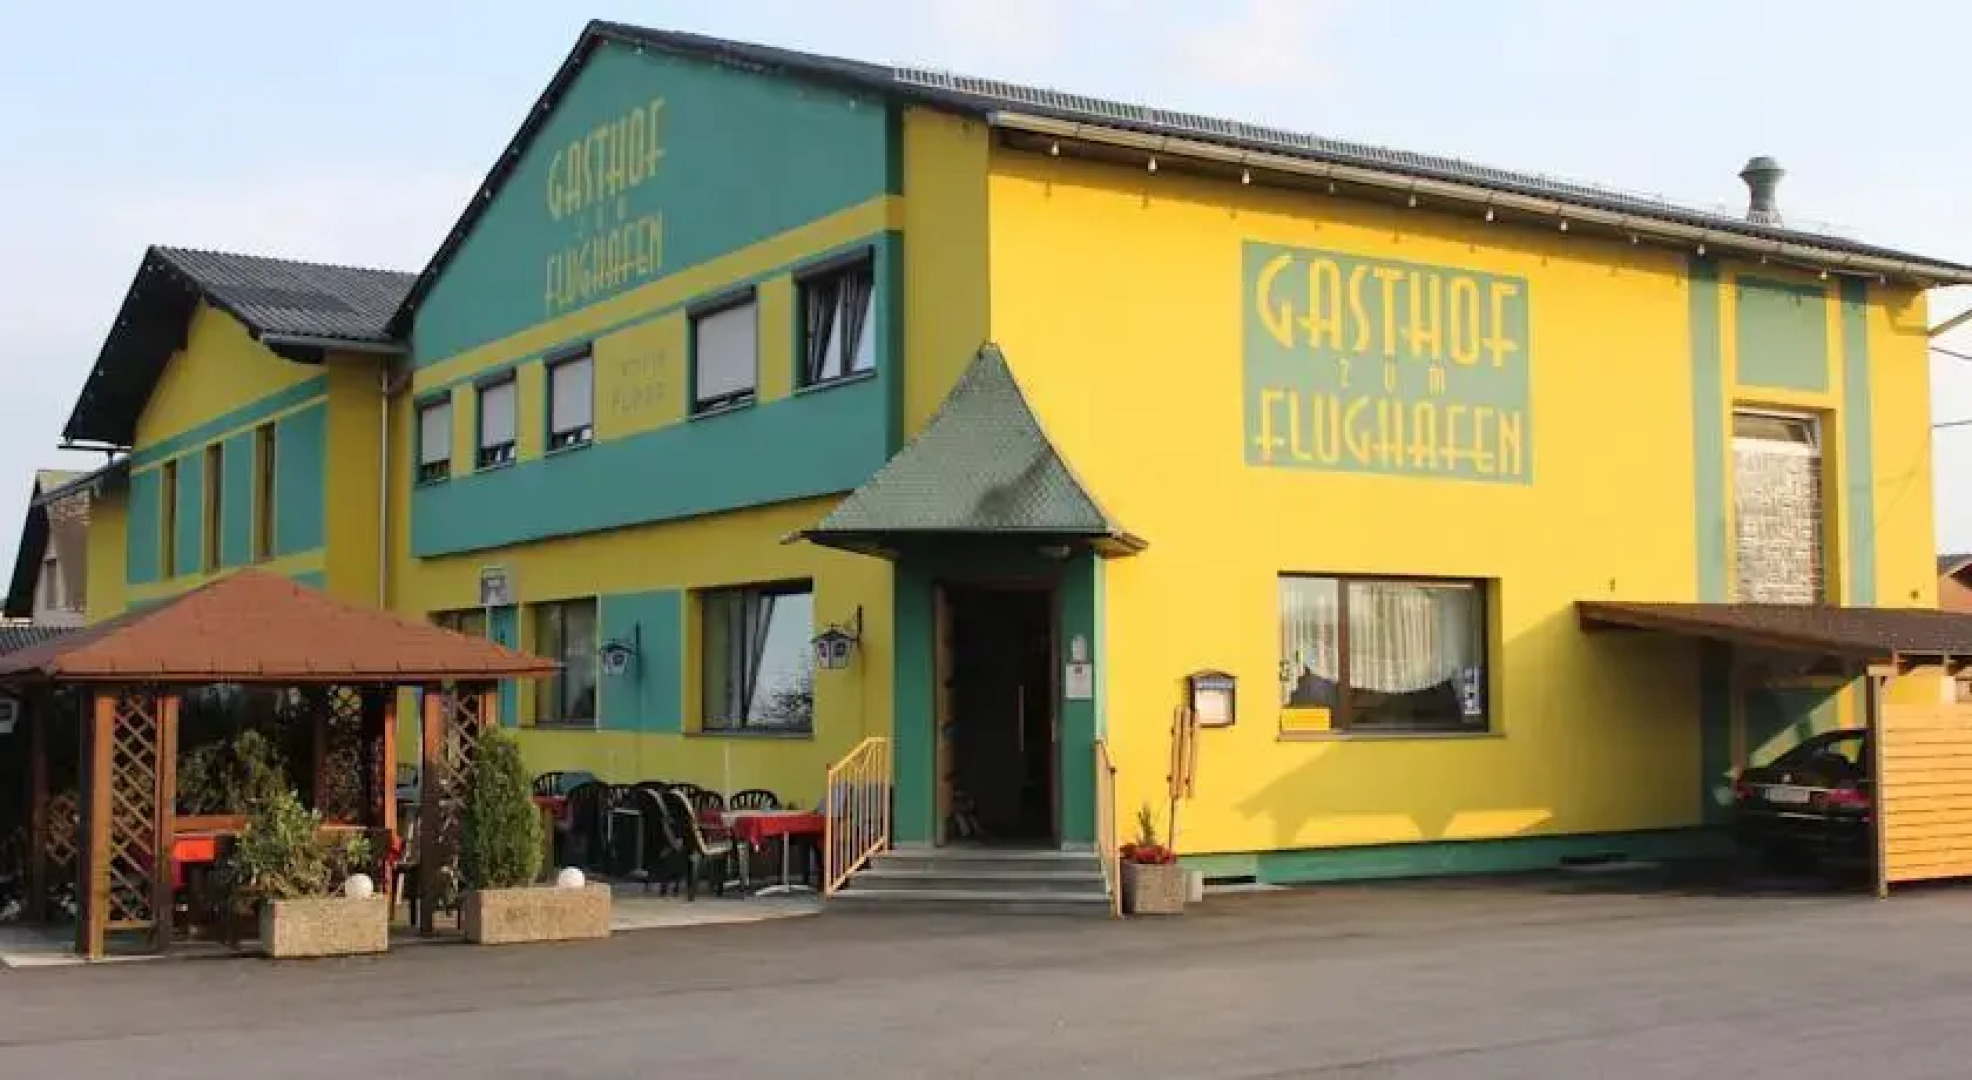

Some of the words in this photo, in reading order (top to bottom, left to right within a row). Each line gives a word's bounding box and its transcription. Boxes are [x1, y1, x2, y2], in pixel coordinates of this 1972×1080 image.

[547, 97, 667, 221] GASTHOF
[1256, 253, 1518, 367] GASTHOF
[1253, 387, 1521, 475] FLUGHAFEN
